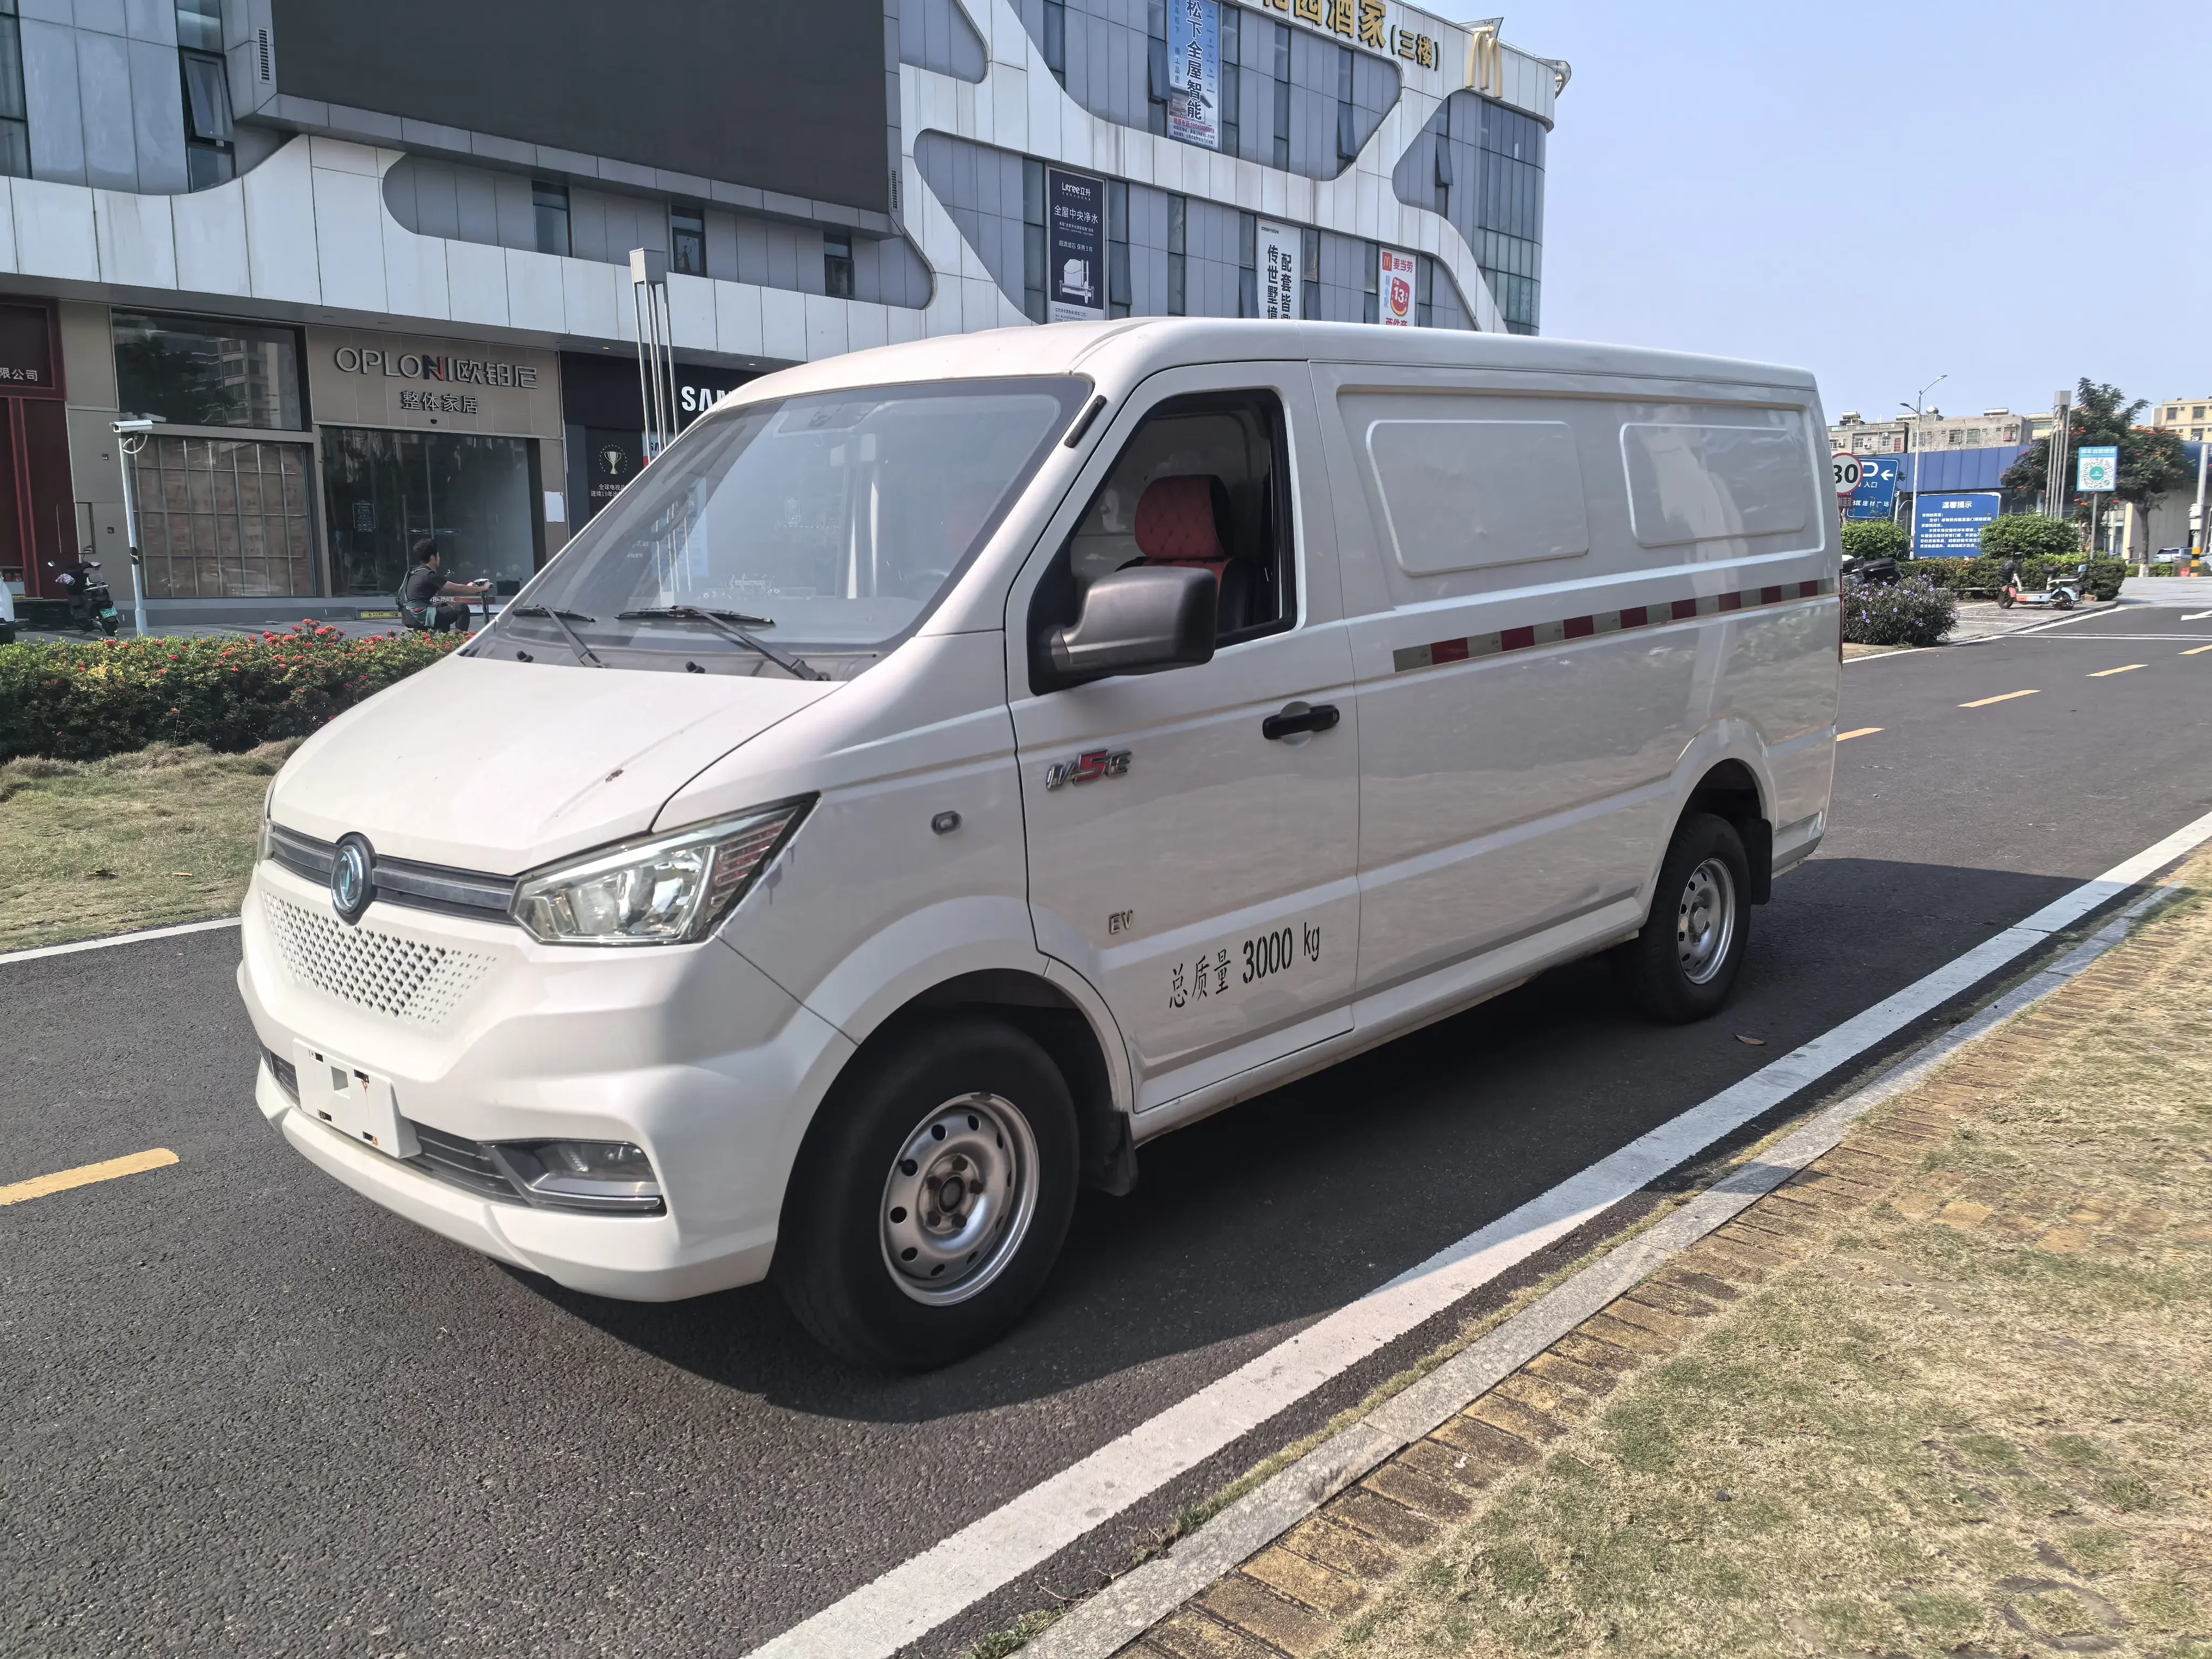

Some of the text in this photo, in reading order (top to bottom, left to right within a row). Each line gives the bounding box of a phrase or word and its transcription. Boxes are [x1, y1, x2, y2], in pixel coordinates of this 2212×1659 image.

[1186, 0, 1202, 120] 松下全屋智能
[1054, 205, 1098, 224] 全屋中央净水
[1393, 258, 1413, 273] 麦当劳
[402, 390, 478, 414] 整体家居
[1833, 464, 1858, 484] 30
[1109, 909, 1133, 935] EV
[1169, 922, 1320, 1009] 总质量 3000 kg
